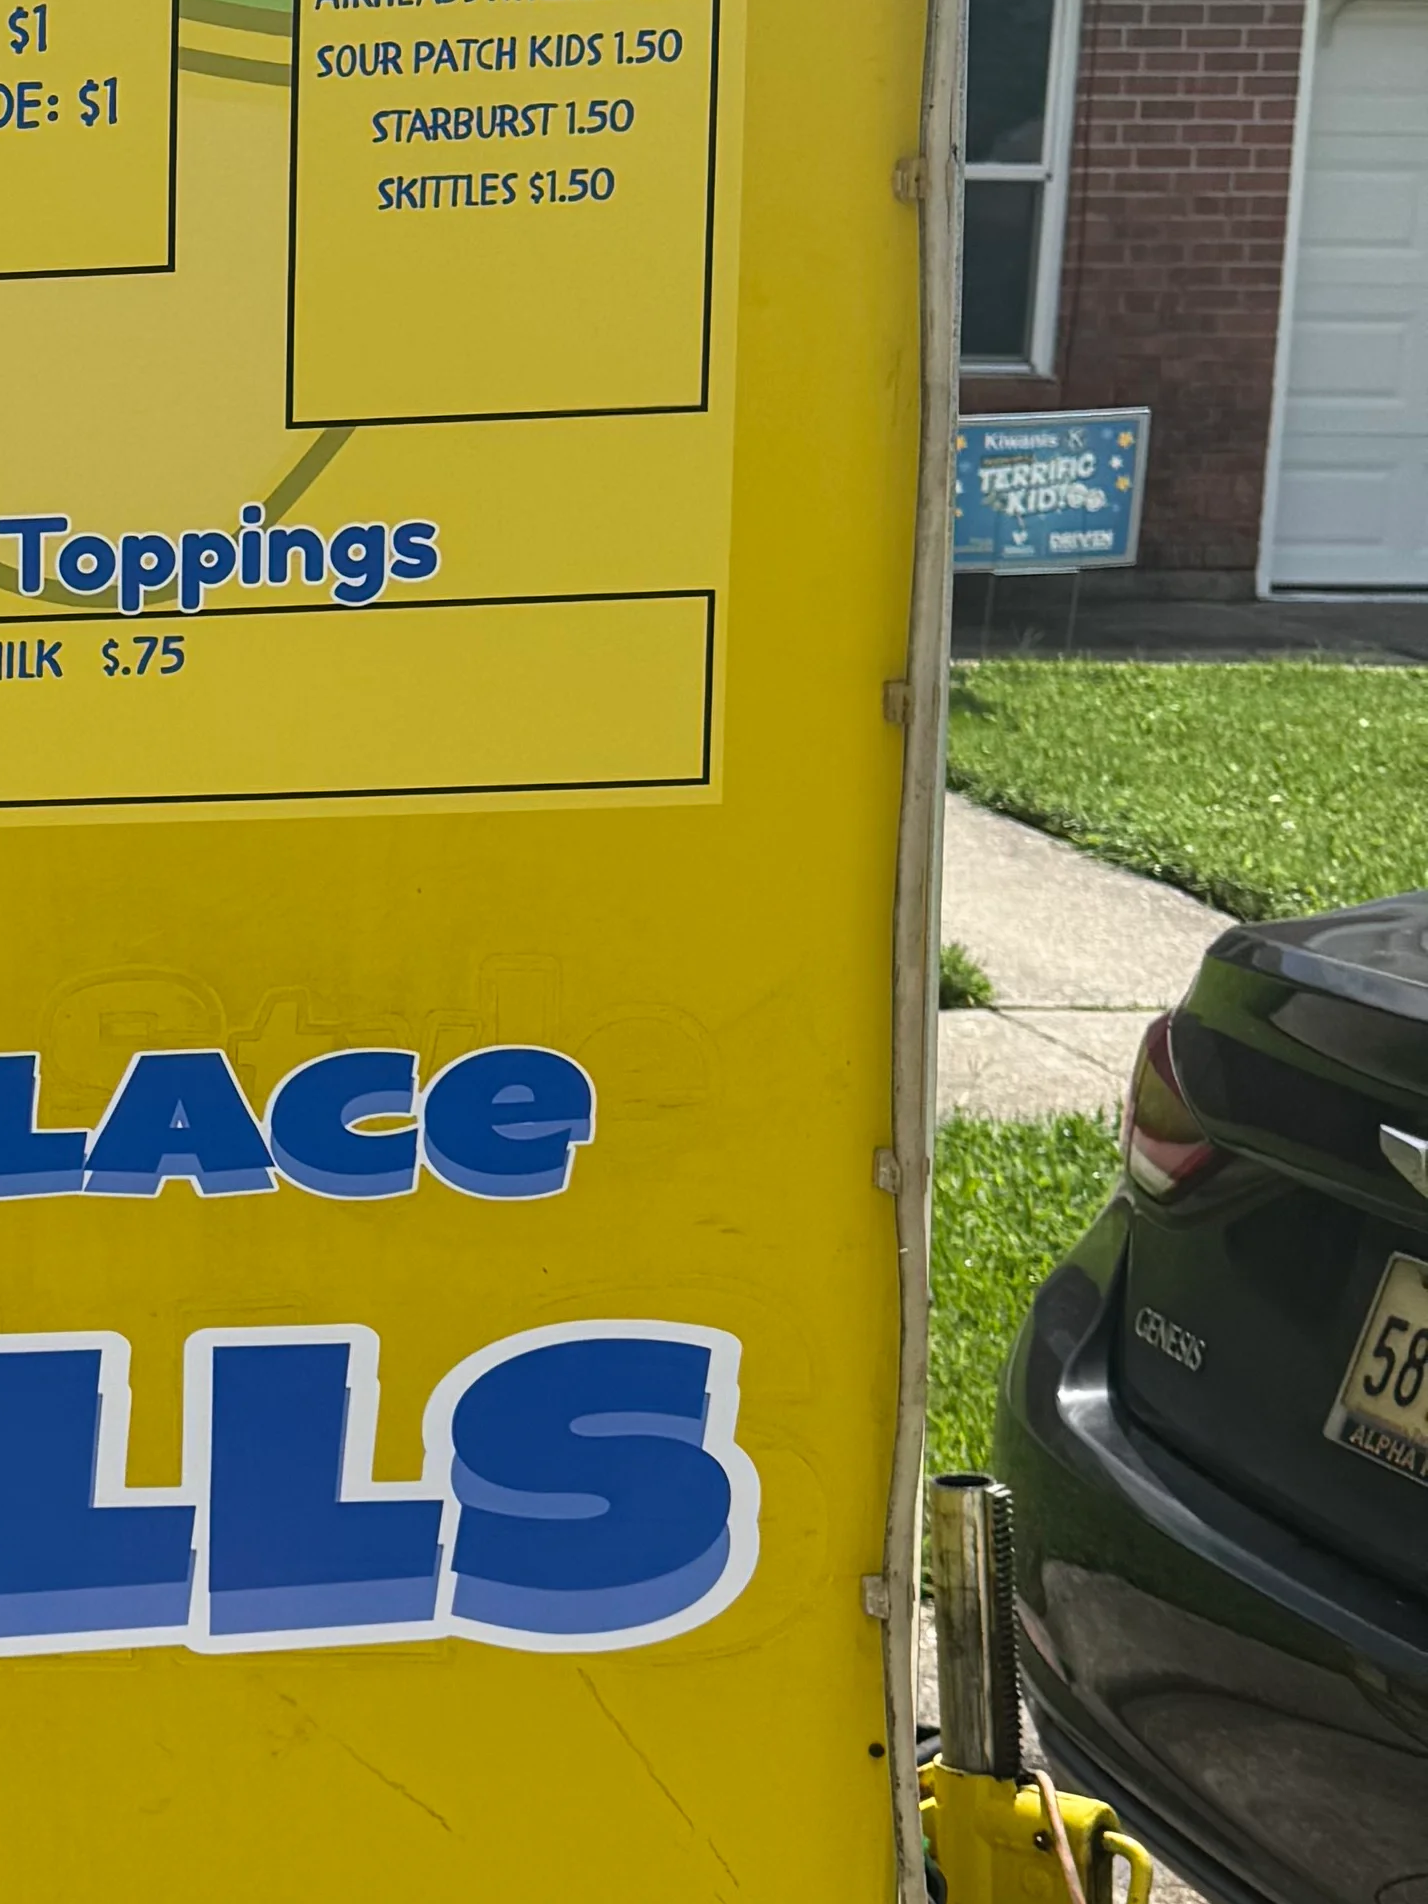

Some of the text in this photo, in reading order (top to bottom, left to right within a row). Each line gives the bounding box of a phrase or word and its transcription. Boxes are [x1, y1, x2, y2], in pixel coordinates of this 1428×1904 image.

[9, 6, 45, 53] $1
[317, 30, 681, 76] SOUR PATCH KIDS 1.50
[79, 79, 116, 125] $1
[373, 101, 633, 142] STARBURST 1.50
[379, 169, 613, 208] SKITTLES $1.50
[978, 453, 1096, 492] TERRIFIC
[103, 637, 183, 675] $.75
[1134, 1305, 1206, 1372] GENESIS
[1349, 1424, 1417, 1471] ALPHA
